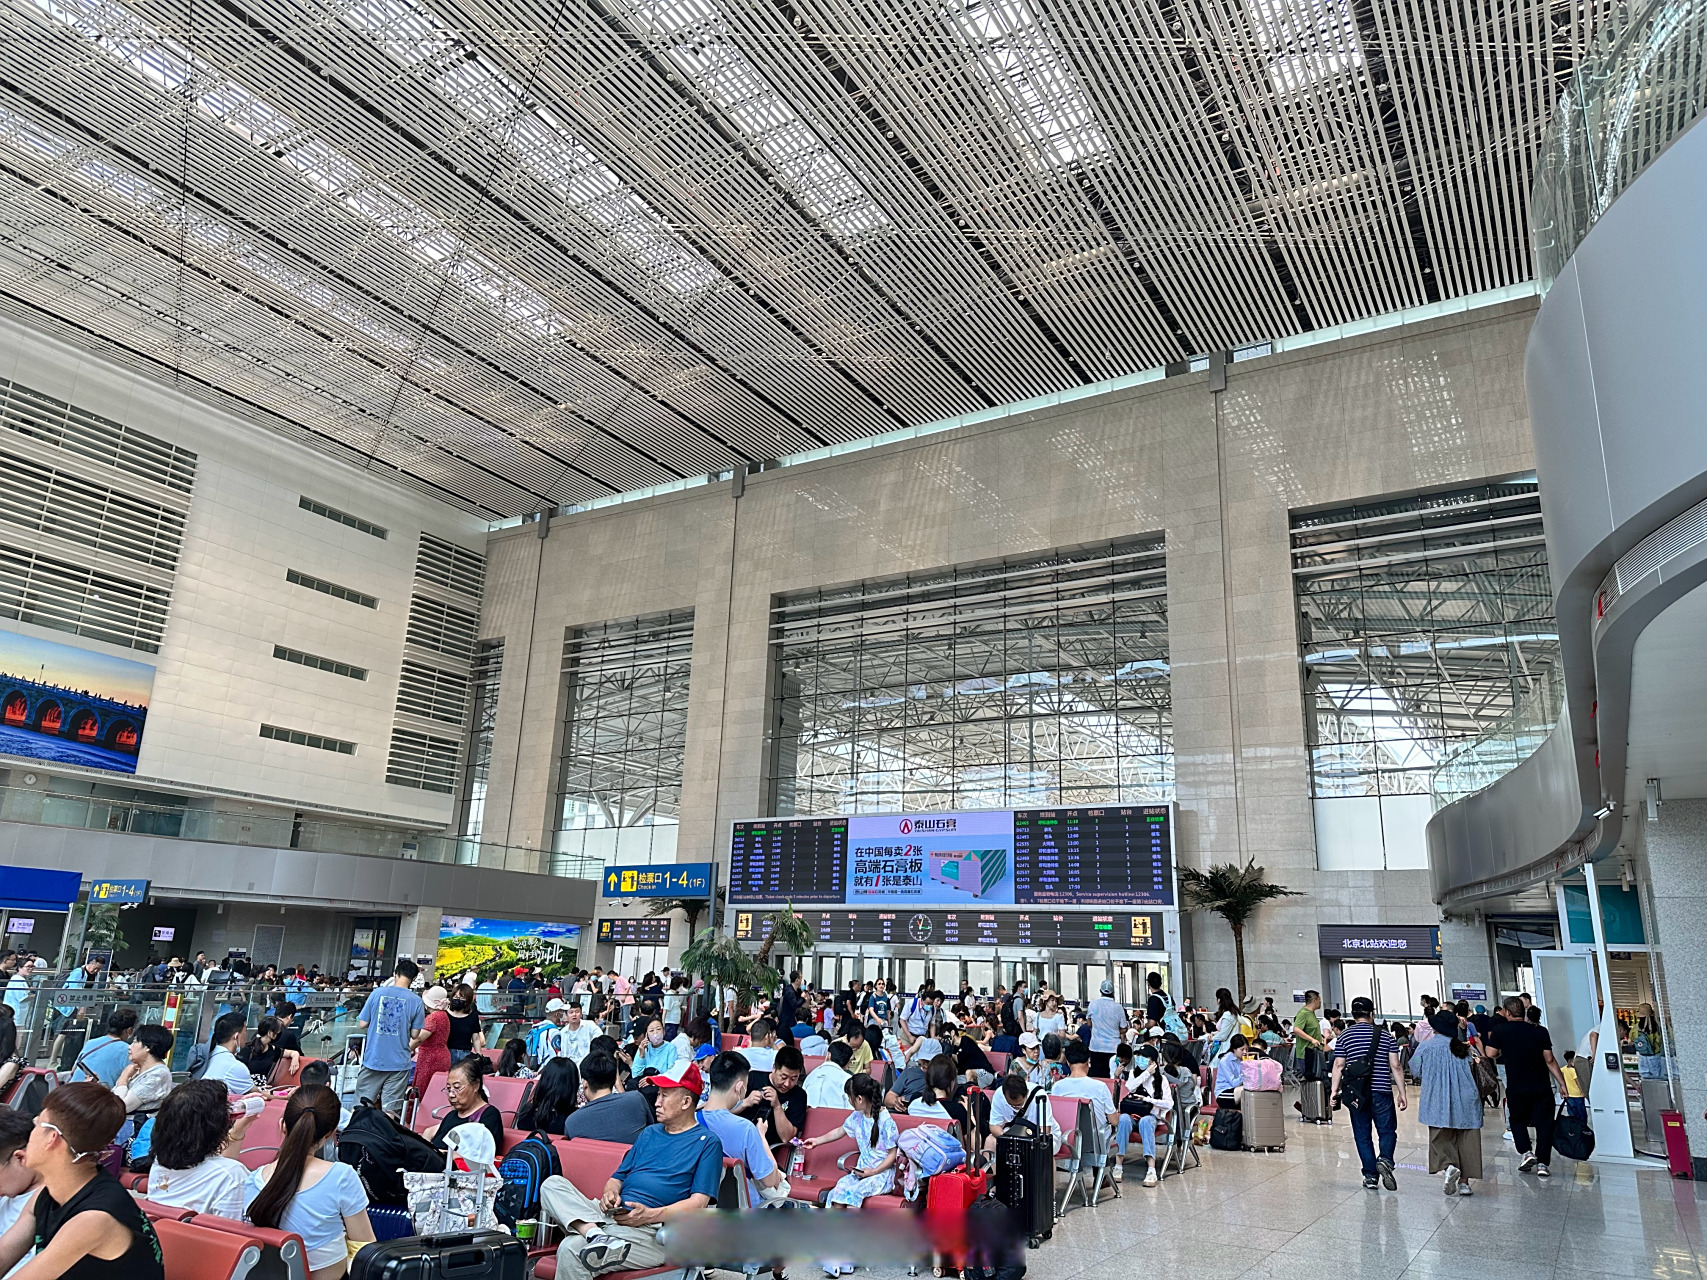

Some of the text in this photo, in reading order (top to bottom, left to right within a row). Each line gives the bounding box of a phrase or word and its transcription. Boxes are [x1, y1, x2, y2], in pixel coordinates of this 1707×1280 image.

[914, 819, 957, 829] 泰山石膏
[855, 844, 923, 857] 在中国每卖2张
[854, 858, 923, 874] 高端石膏板
[639, 871, 706, 888] 检票口 1-4 (1F)
[854, 874, 922, 887] 就有1张是泰山
[122, 885, 135, 897] 1-4
[1342, 939, 1407, 949] 北京北站欢迎您
